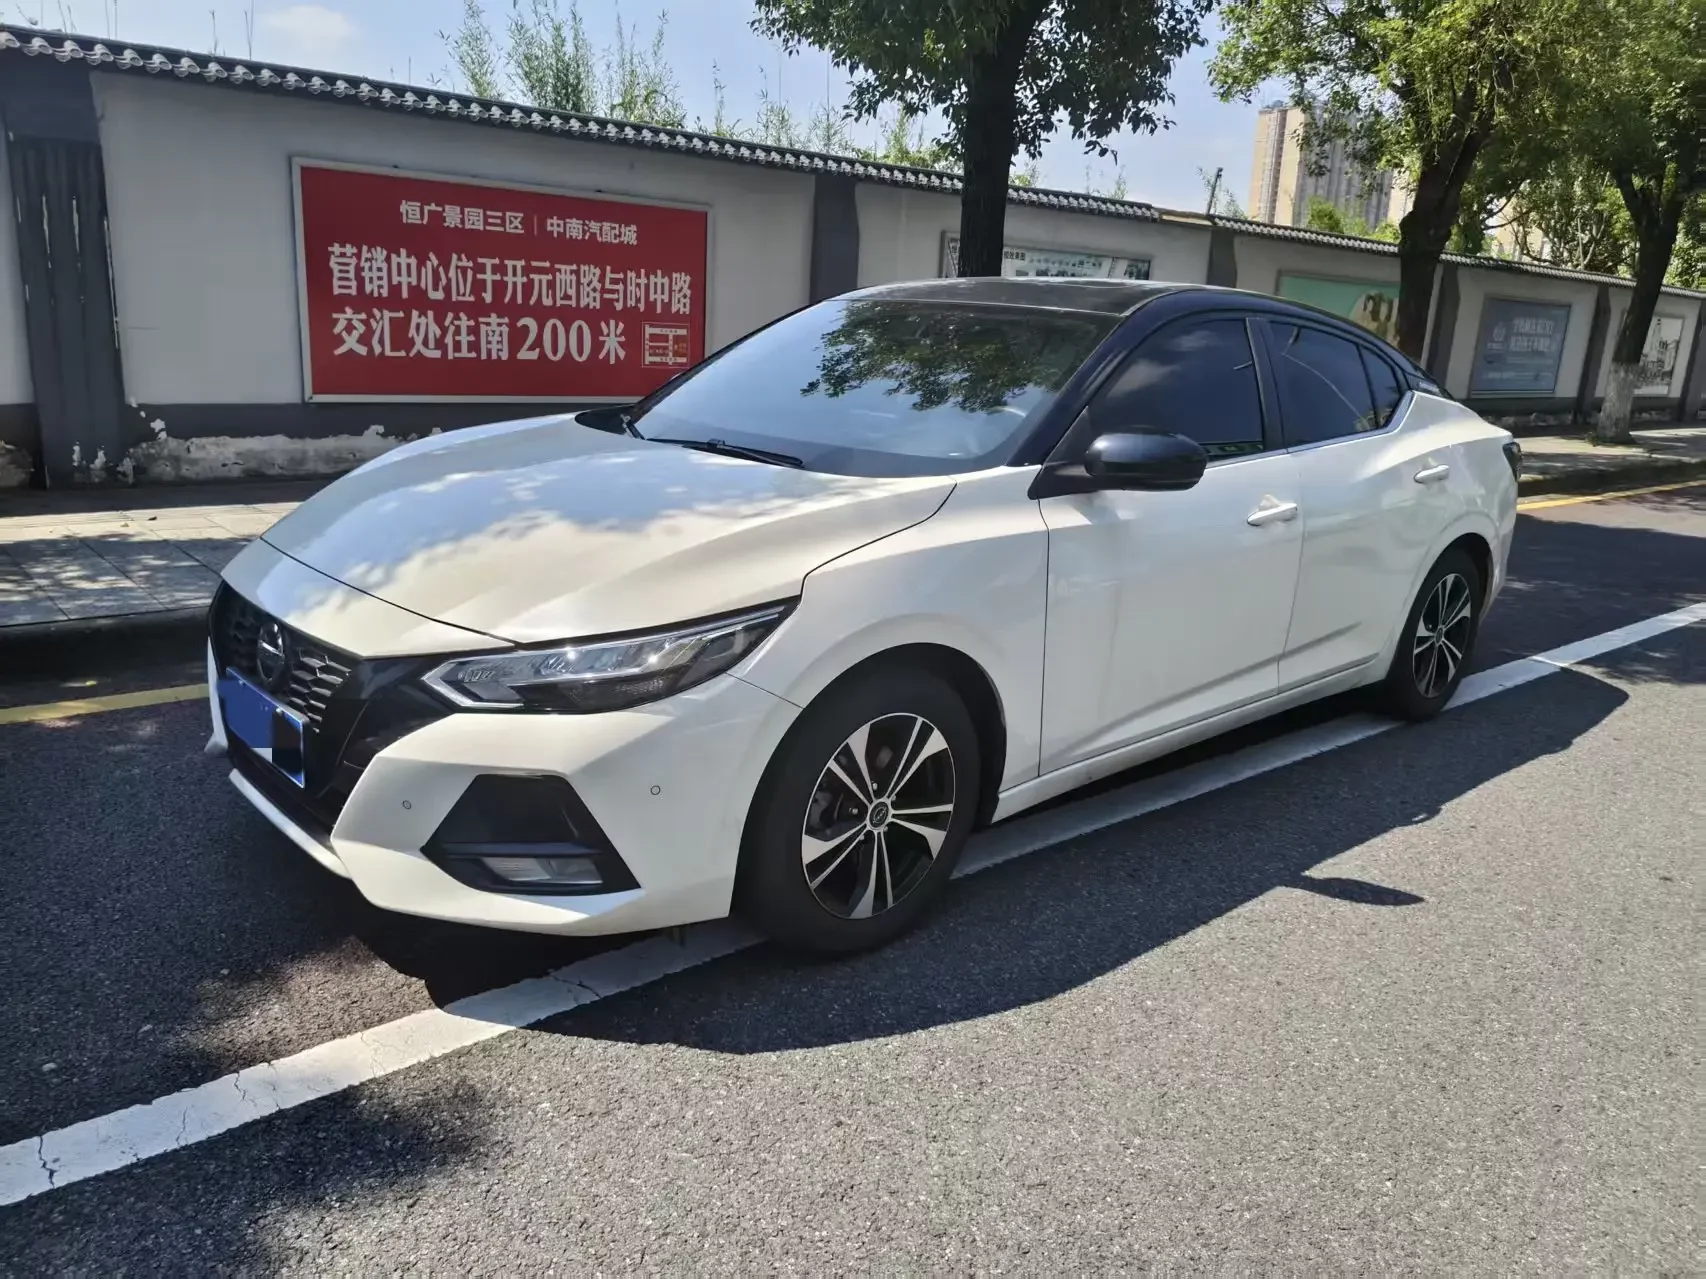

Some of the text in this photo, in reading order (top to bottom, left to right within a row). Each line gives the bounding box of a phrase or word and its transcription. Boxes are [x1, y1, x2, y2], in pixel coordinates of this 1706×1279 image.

[400, 200, 638, 246] 恒广景园三区 中南汽配城
[328, 242, 692, 315] 营销中心位于开元西路与时中路
[331, 306, 627, 365] 交汇处往南200米
